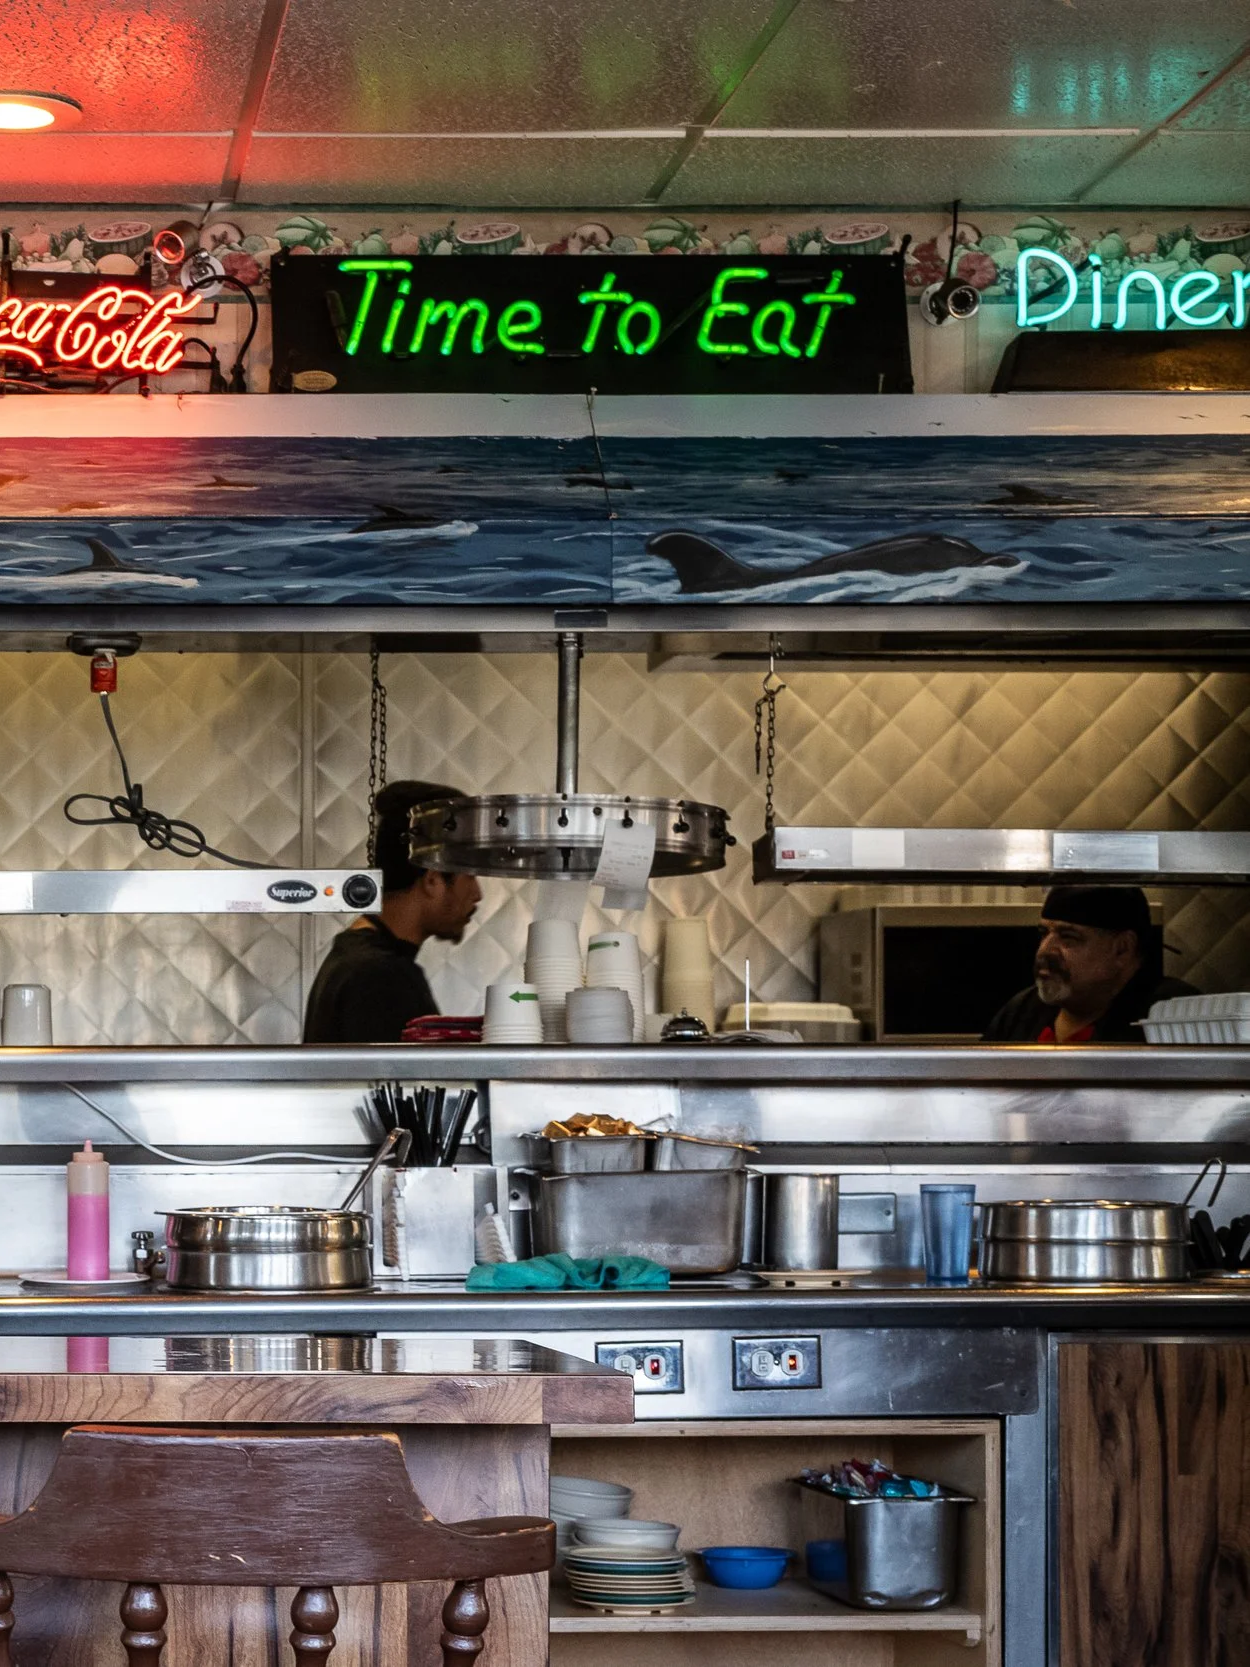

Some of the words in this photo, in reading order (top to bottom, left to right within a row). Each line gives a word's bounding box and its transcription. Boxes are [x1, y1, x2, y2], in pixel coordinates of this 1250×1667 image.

[338, 259, 545, 356] Time
[579, 271, 663, 356] to
[697, 265, 857, 358] Eat
[1016, 248, 1250, 330] Diner
[271, 886, 314, 900] Superior
